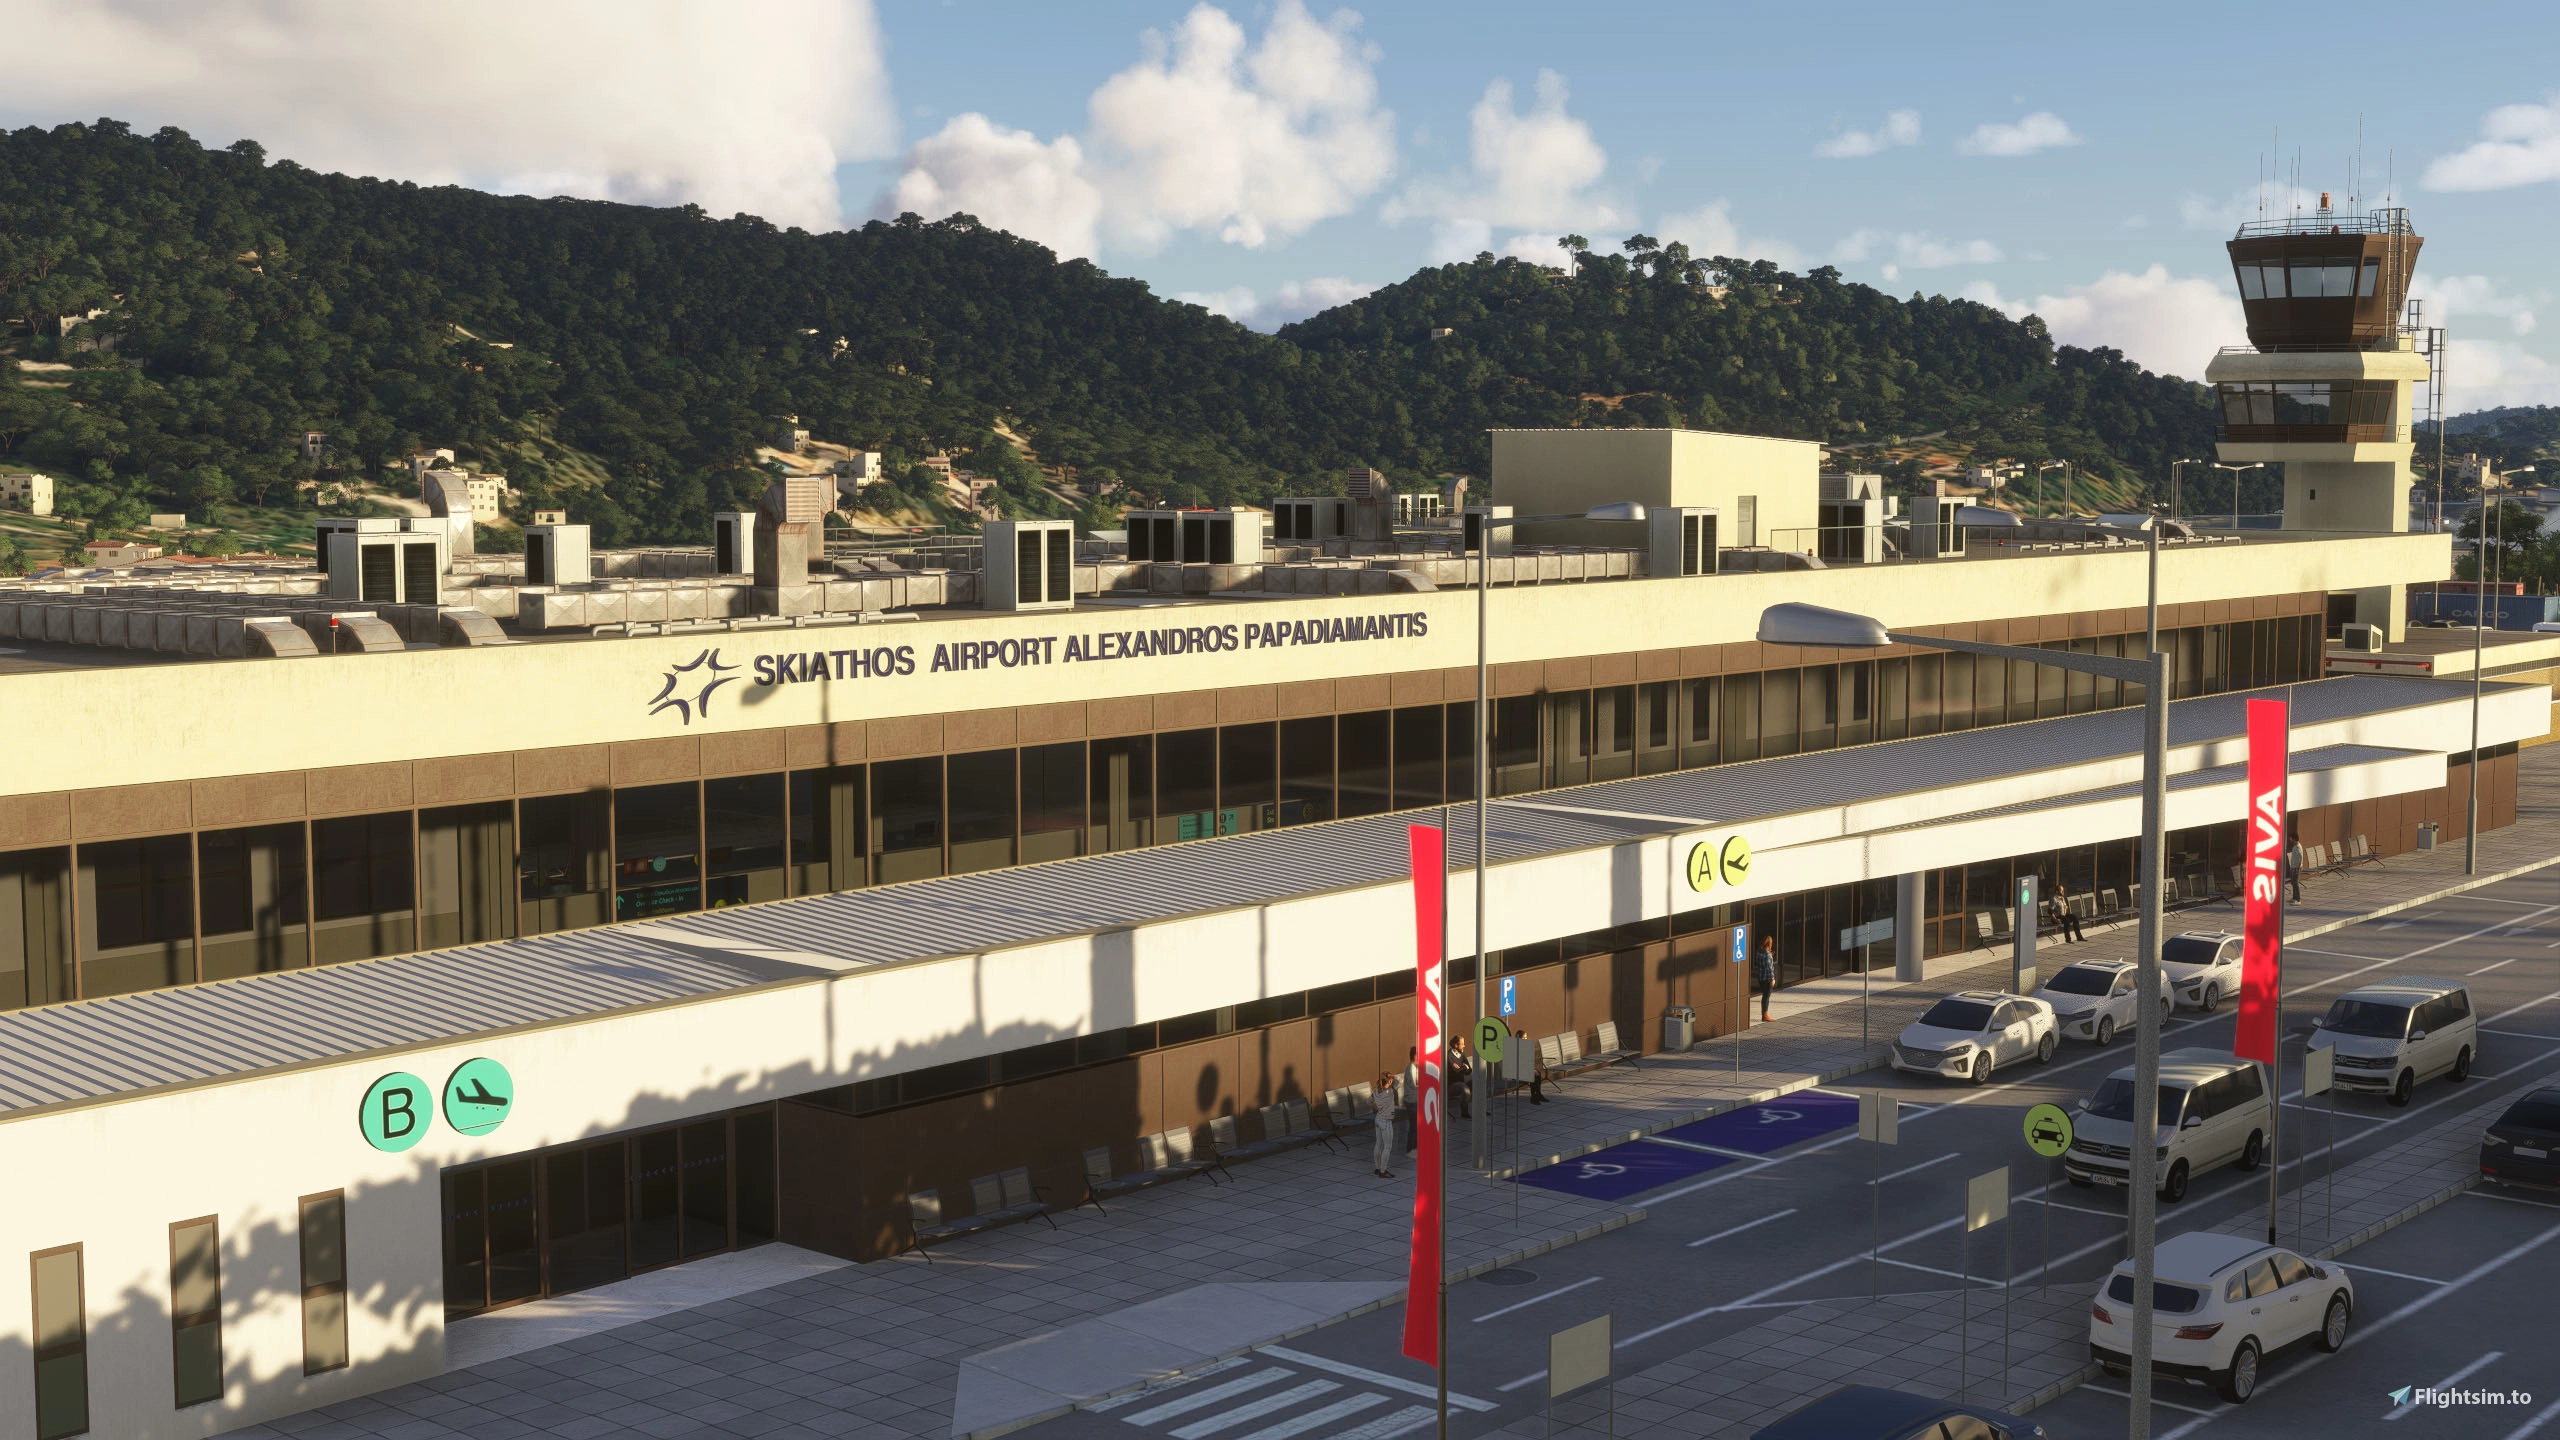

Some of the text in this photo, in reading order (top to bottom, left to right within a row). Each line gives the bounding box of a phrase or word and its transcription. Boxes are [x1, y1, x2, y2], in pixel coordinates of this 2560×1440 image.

[753, 611, 1428, 686] SKIATHOS AIRPORT ALEXANDROS PAPADIAMANTIS
[1697, 850, 1712, 883] A
[1736, 928, 1744, 946] P
[1503, 979, 1513, 998] P
[1482, 1025, 1498, 1050] P
[382, 1087, 416, 1139] B
